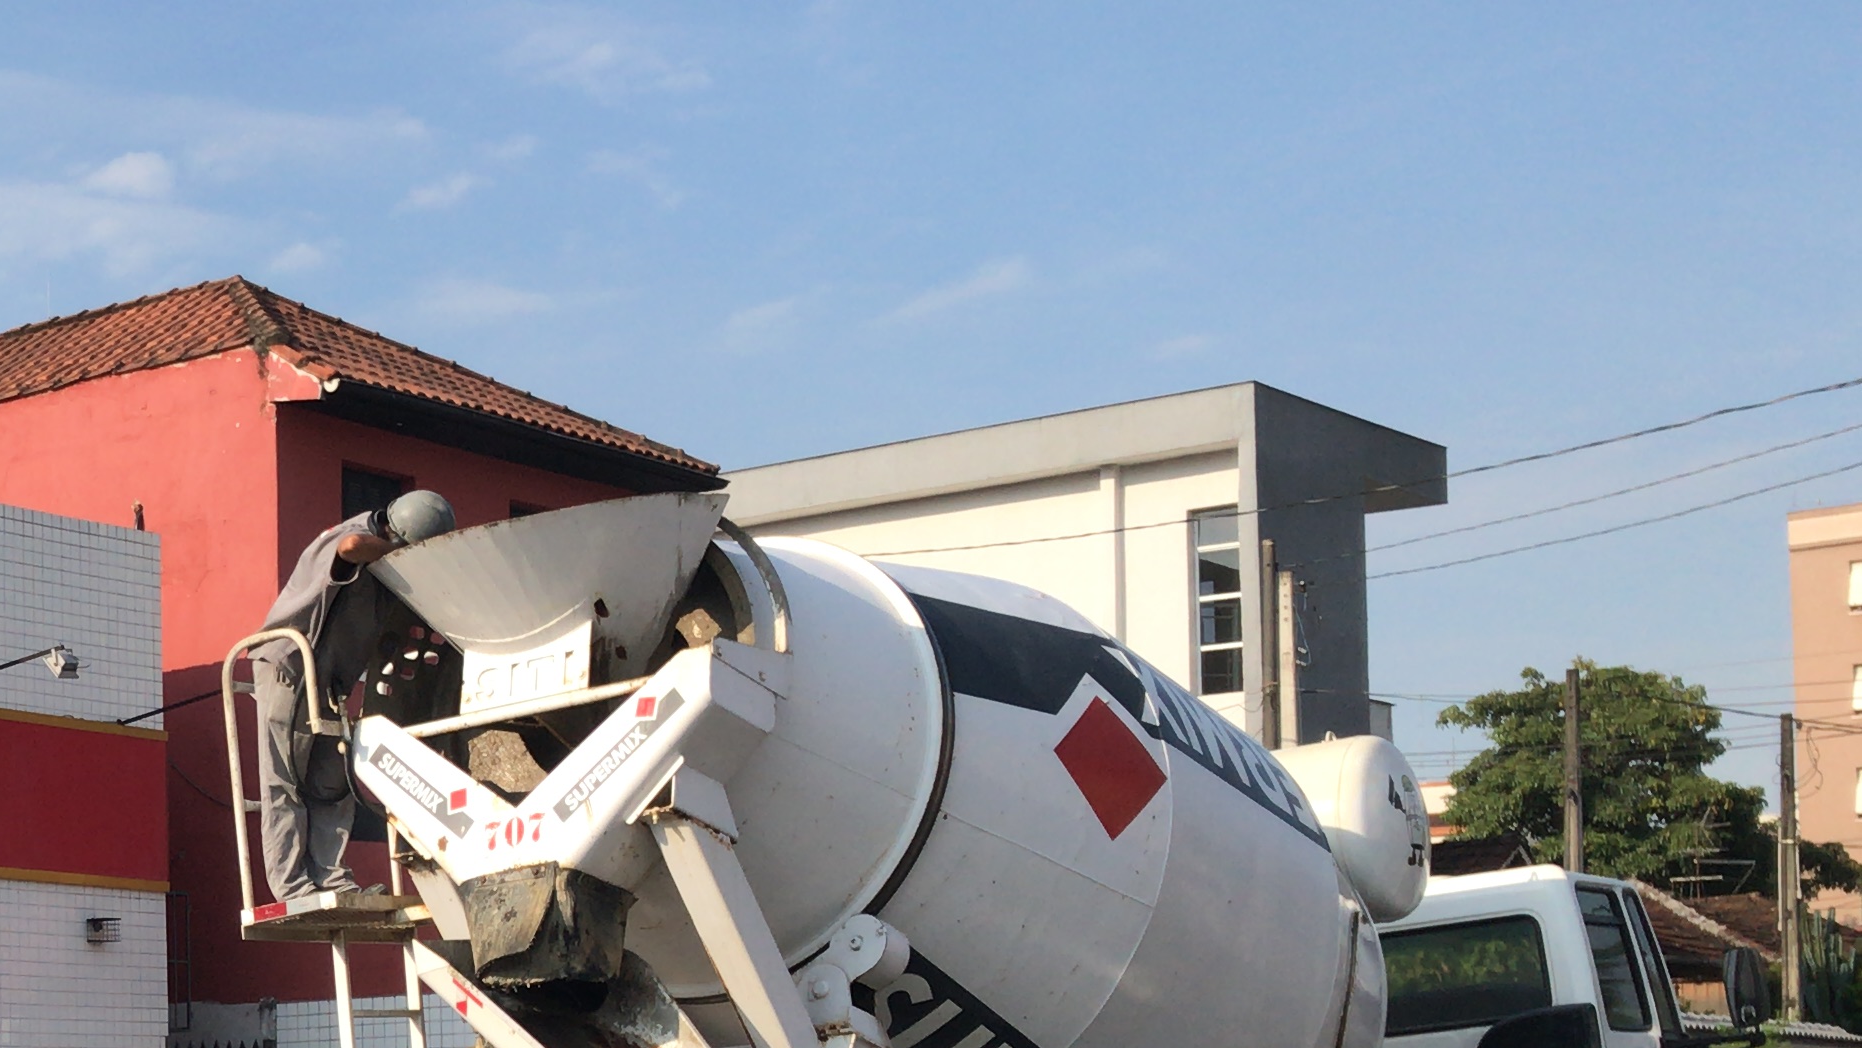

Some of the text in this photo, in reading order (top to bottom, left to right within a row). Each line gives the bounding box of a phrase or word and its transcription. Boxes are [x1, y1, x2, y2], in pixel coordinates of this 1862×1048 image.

[377, 753, 444, 814] SUPERMIX
[565, 725, 648, 811] SUPERMIX
[485, 812, 546, 851] 707
